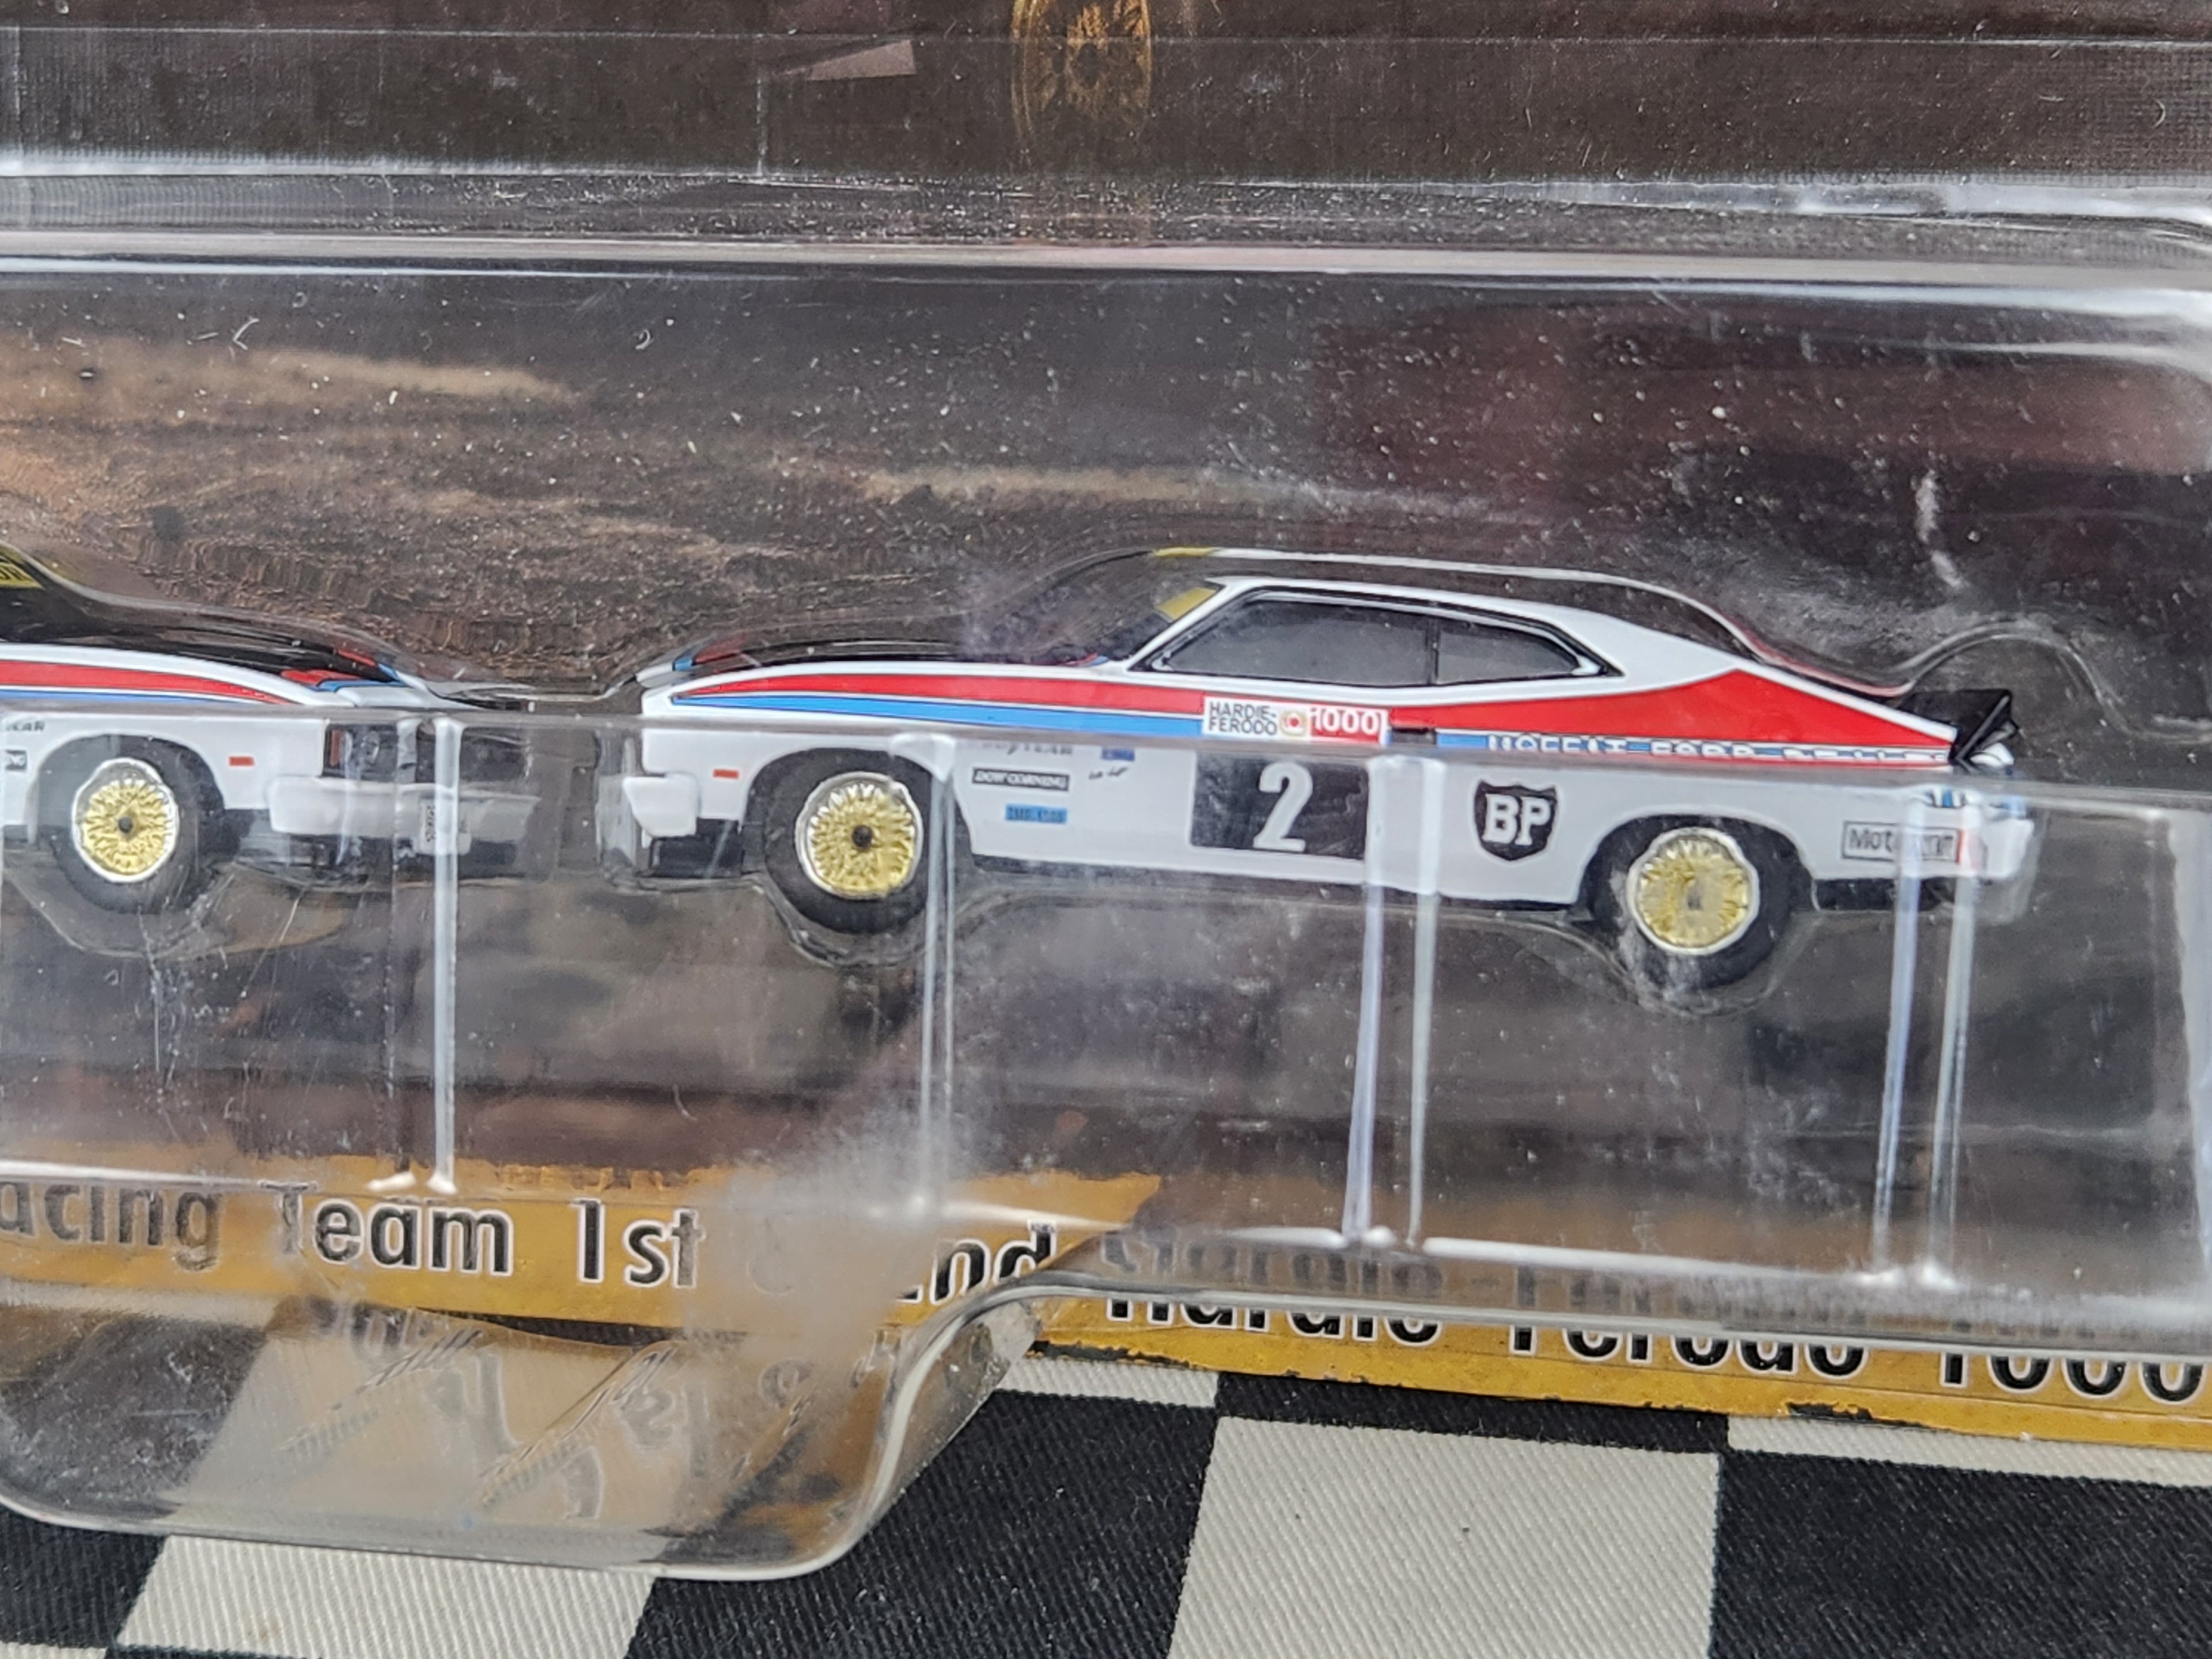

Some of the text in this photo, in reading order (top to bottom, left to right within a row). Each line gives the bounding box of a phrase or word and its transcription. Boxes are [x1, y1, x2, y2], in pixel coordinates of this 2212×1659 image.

[1209, 715, 1278, 736] FERODO
[1311, 708, 1379, 736] 1000
[1253, 762, 1313, 853] 2
[1482, 793, 1551, 845] BP
[259, 1180, 514, 1277] Team
[576, 1198, 704, 1288] 1st
